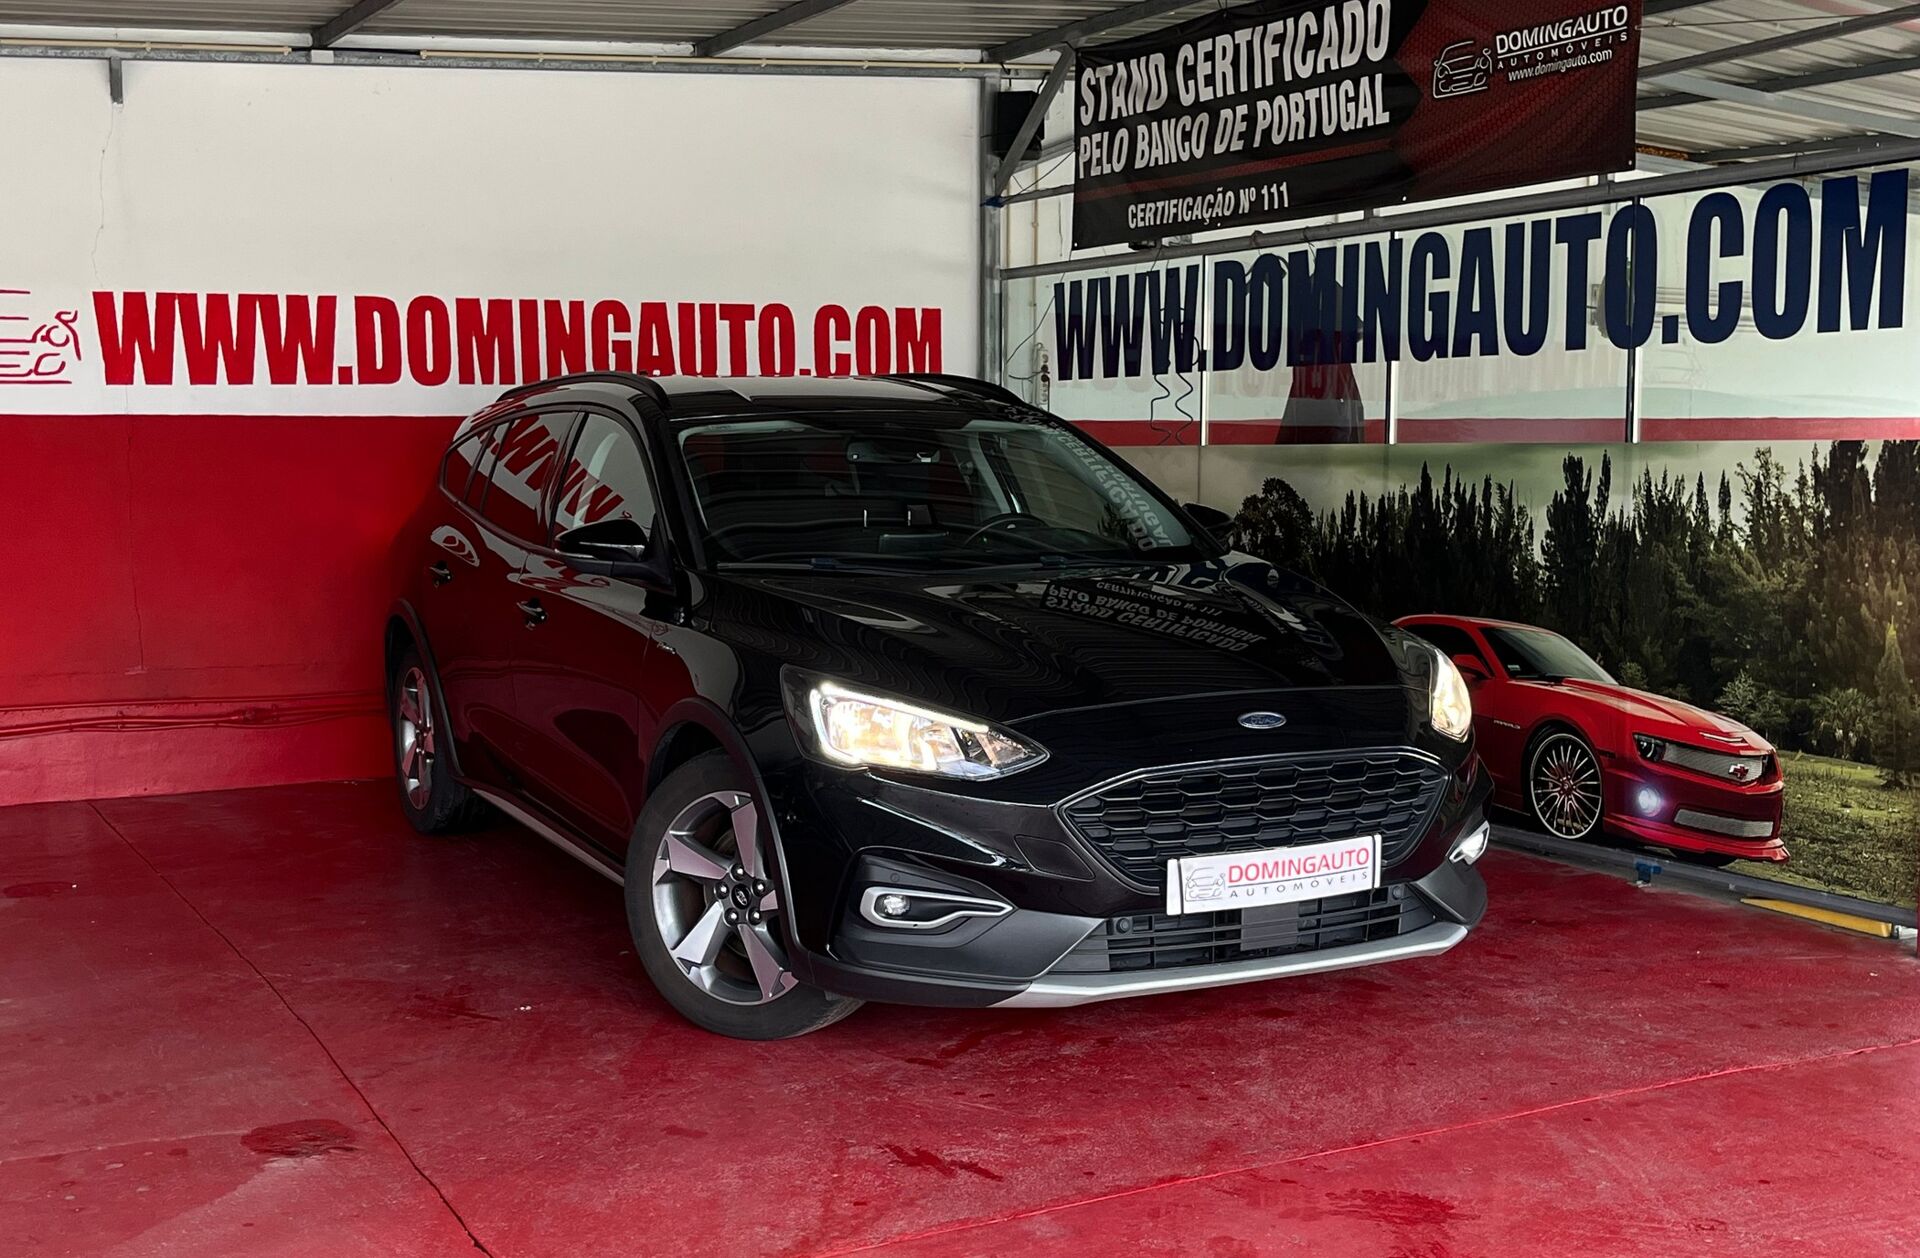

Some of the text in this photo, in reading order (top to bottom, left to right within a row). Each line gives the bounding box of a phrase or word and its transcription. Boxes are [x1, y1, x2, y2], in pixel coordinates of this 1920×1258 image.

[1496, 5, 1628, 54] DOMINGAUTO
[1497, 32, 1627, 69] AUTOMÓVEIS
[1080, 0, 1391, 126] STAND CERTIFICADO
[1508, 49, 1612, 82] www.domingauto.com
[1079, 73, 1390, 179] PELO BANCO DE PORTUGAL
[1128, 187, 1233, 229] CERTIFICAÇÃO
[1261, 181, 1289, 211] 111
[1054, 168, 1909, 381] WWW.DOMINGAUTO.COM
[92, 291, 942, 386] WWW.DOMINGAUTO.COM
[1228, 848, 1369, 883] DOMINGAUTO
[1230, 871, 1367, 898] AUTOMÓVEIS
